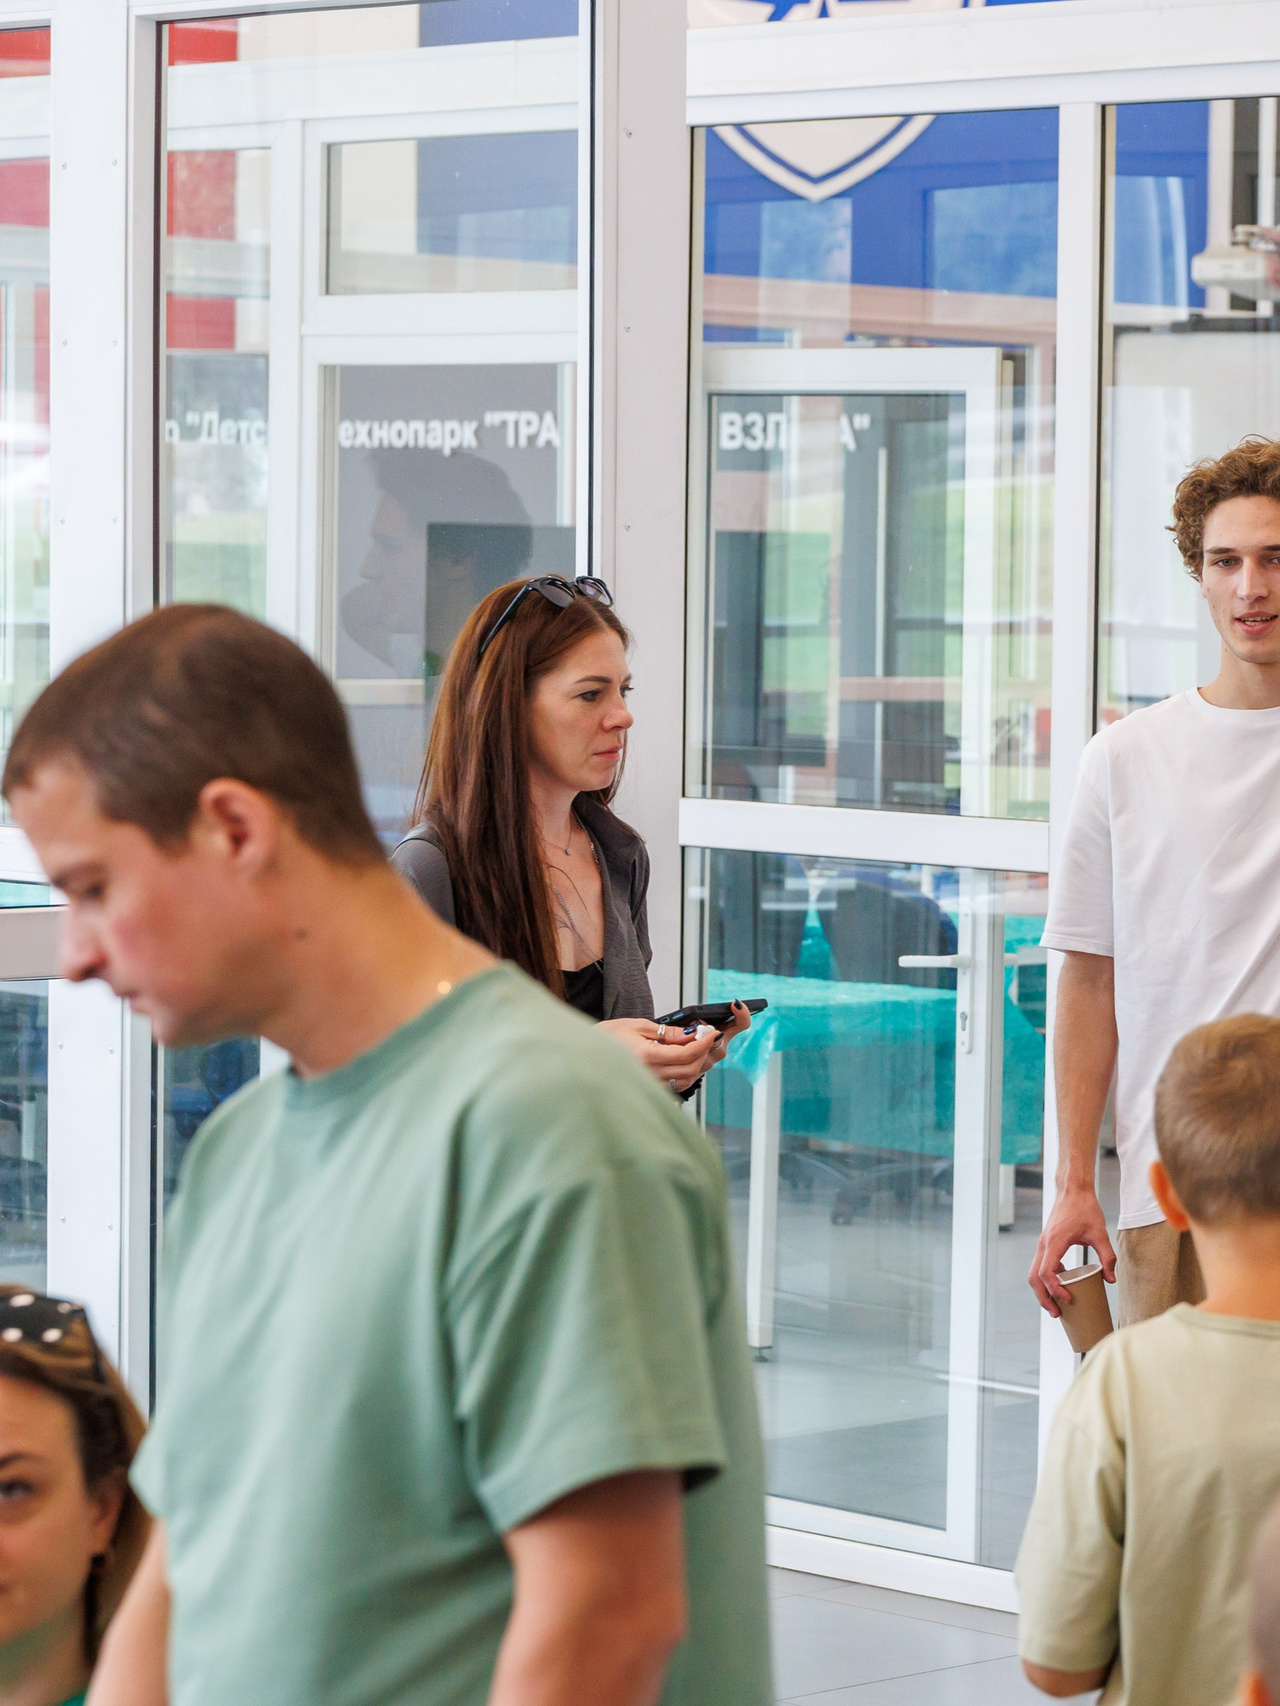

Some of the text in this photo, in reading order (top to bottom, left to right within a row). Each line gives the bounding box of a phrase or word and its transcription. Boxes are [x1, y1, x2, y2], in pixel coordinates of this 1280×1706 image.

[338, 419, 479, 457] ехнопарк
[483, 410, 561, 449] "ТРА
[718, 411, 871, 452] ВЗЛА"
